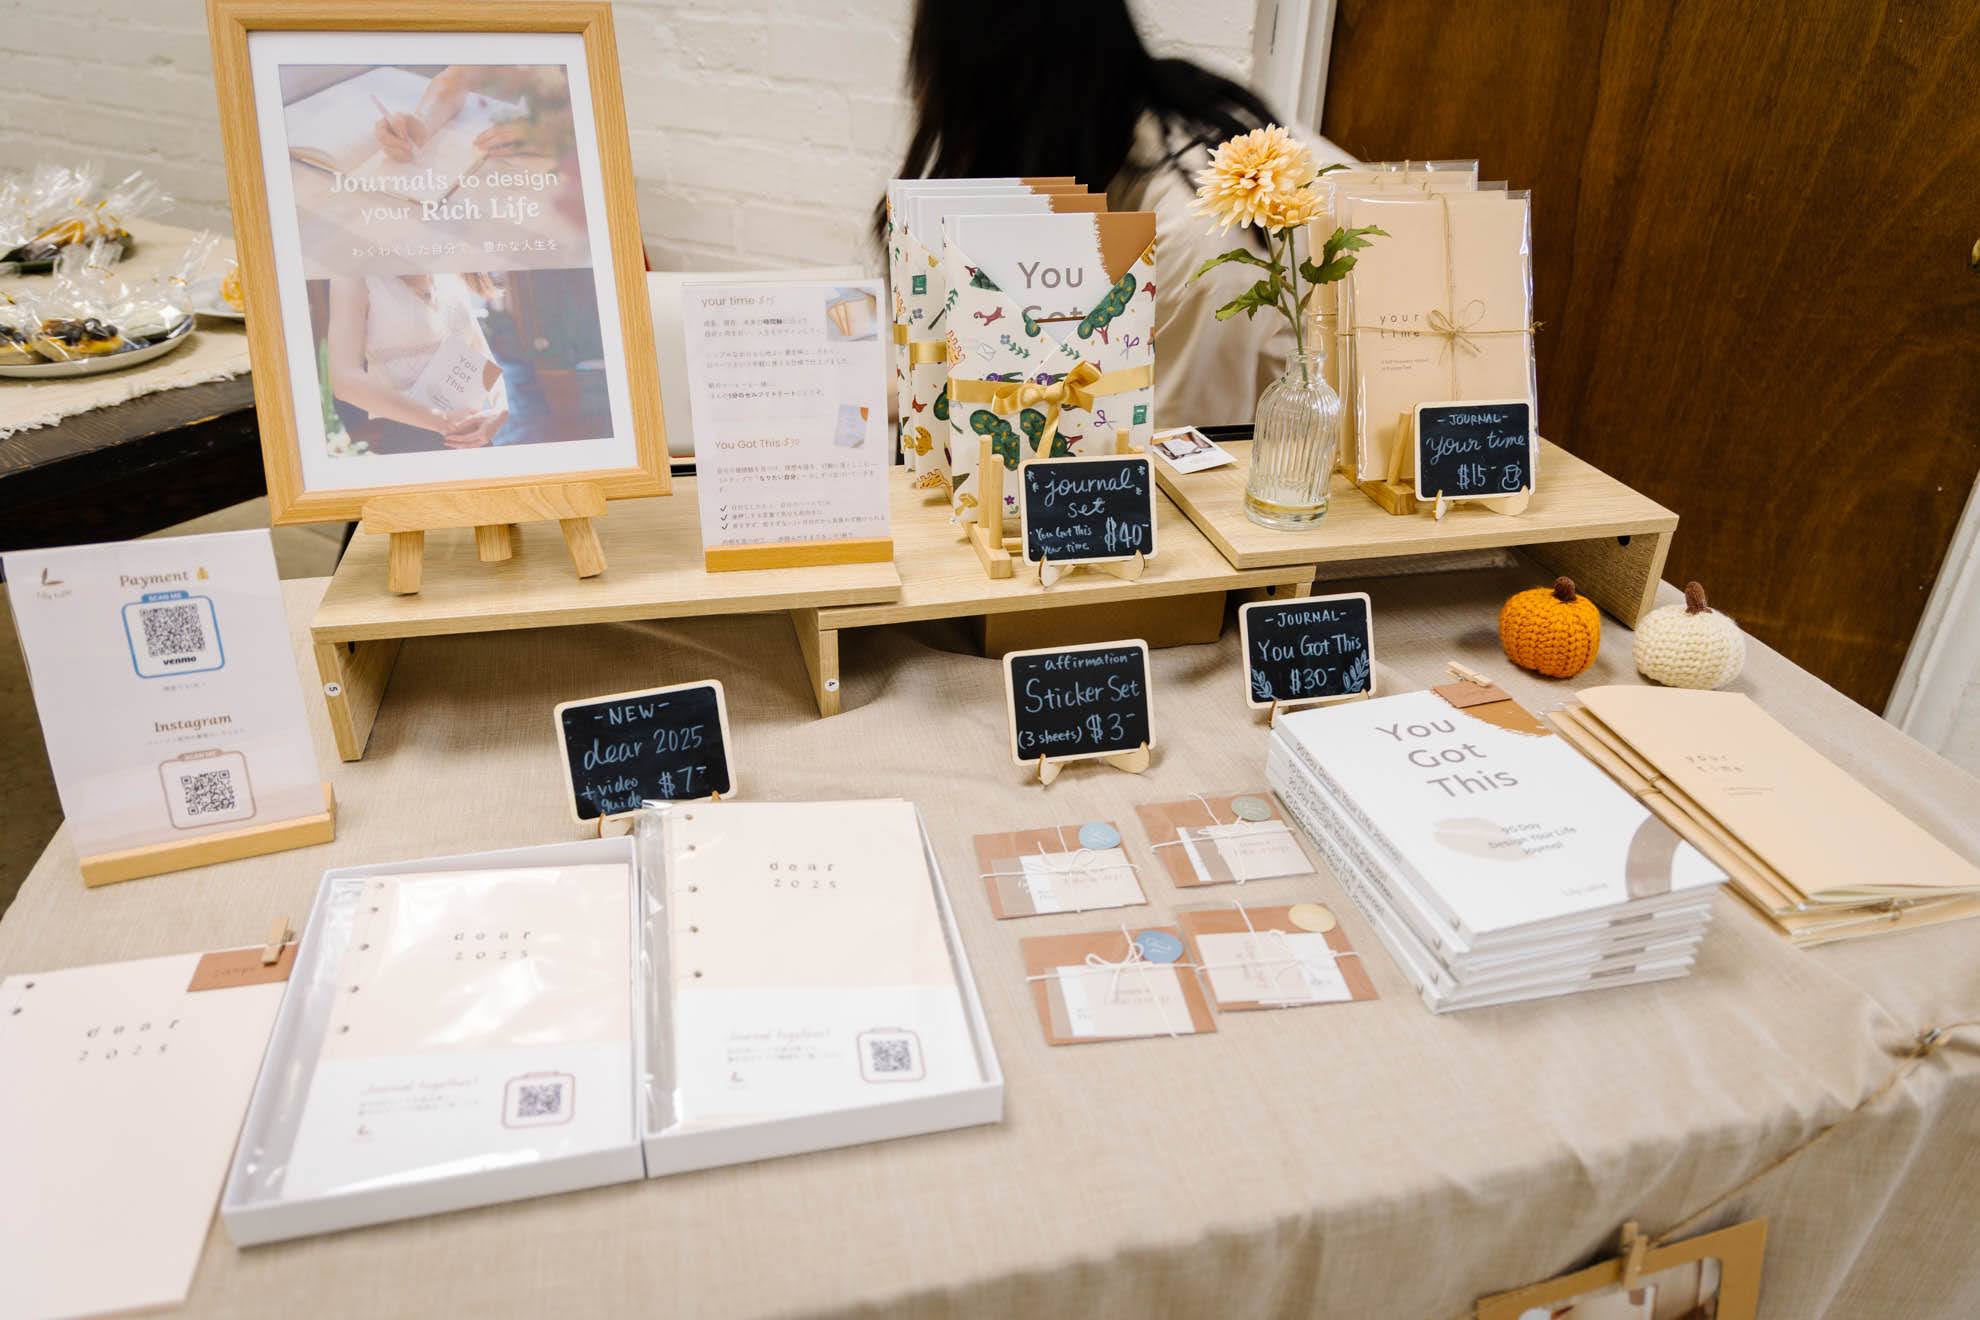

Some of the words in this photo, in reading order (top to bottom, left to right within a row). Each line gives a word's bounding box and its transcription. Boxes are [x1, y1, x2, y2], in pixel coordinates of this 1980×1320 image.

[330, 168, 449, 193] Journals
[458, 174, 480, 189] to
[486, 170, 558, 191] design
[360, 207, 410, 224] your
[420, 198, 482, 222] Rich
[491, 195, 541, 225] Life
[1017, 261, 1084, 289] You
[701, 297, 725, 308] your
[729, 296, 754, 305] time
[1380, 314, 1419, 325] your
[1380, 328, 1420, 339] time
[714, 440, 734, 450] You
[737, 439, 757, 449] Got
[760, 439, 781, 448] This
[1426, 436, 1482, 466] your
[1487, 430, 1526, 449] time
[1035, 528, 1053, 541] You
[1055, 526, 1072, 539] Got
[1072, 525, 1092, 536] This
[1066, 541, 1090, 553] time
[119, 570, 189, 589] Payment
[1257, 639, 1295, 662] You
[1300, 634, 1332, 657] Got
[1331, 633, 1362, 654] This
[163, 655, 197, 666] venmo
[1025, 678, 1104, 713] Sticker
[1107, 674, 1140, 702] Set
[155, 714, 232, 733] Instagram
[1374, 719, 1456, 742] You
[583, 738, 643, 770] dear
[653, 725, 704, 754] 2025
[1408, 743, 1487, 768] Got
[1426, 770, 1519, 797] This
